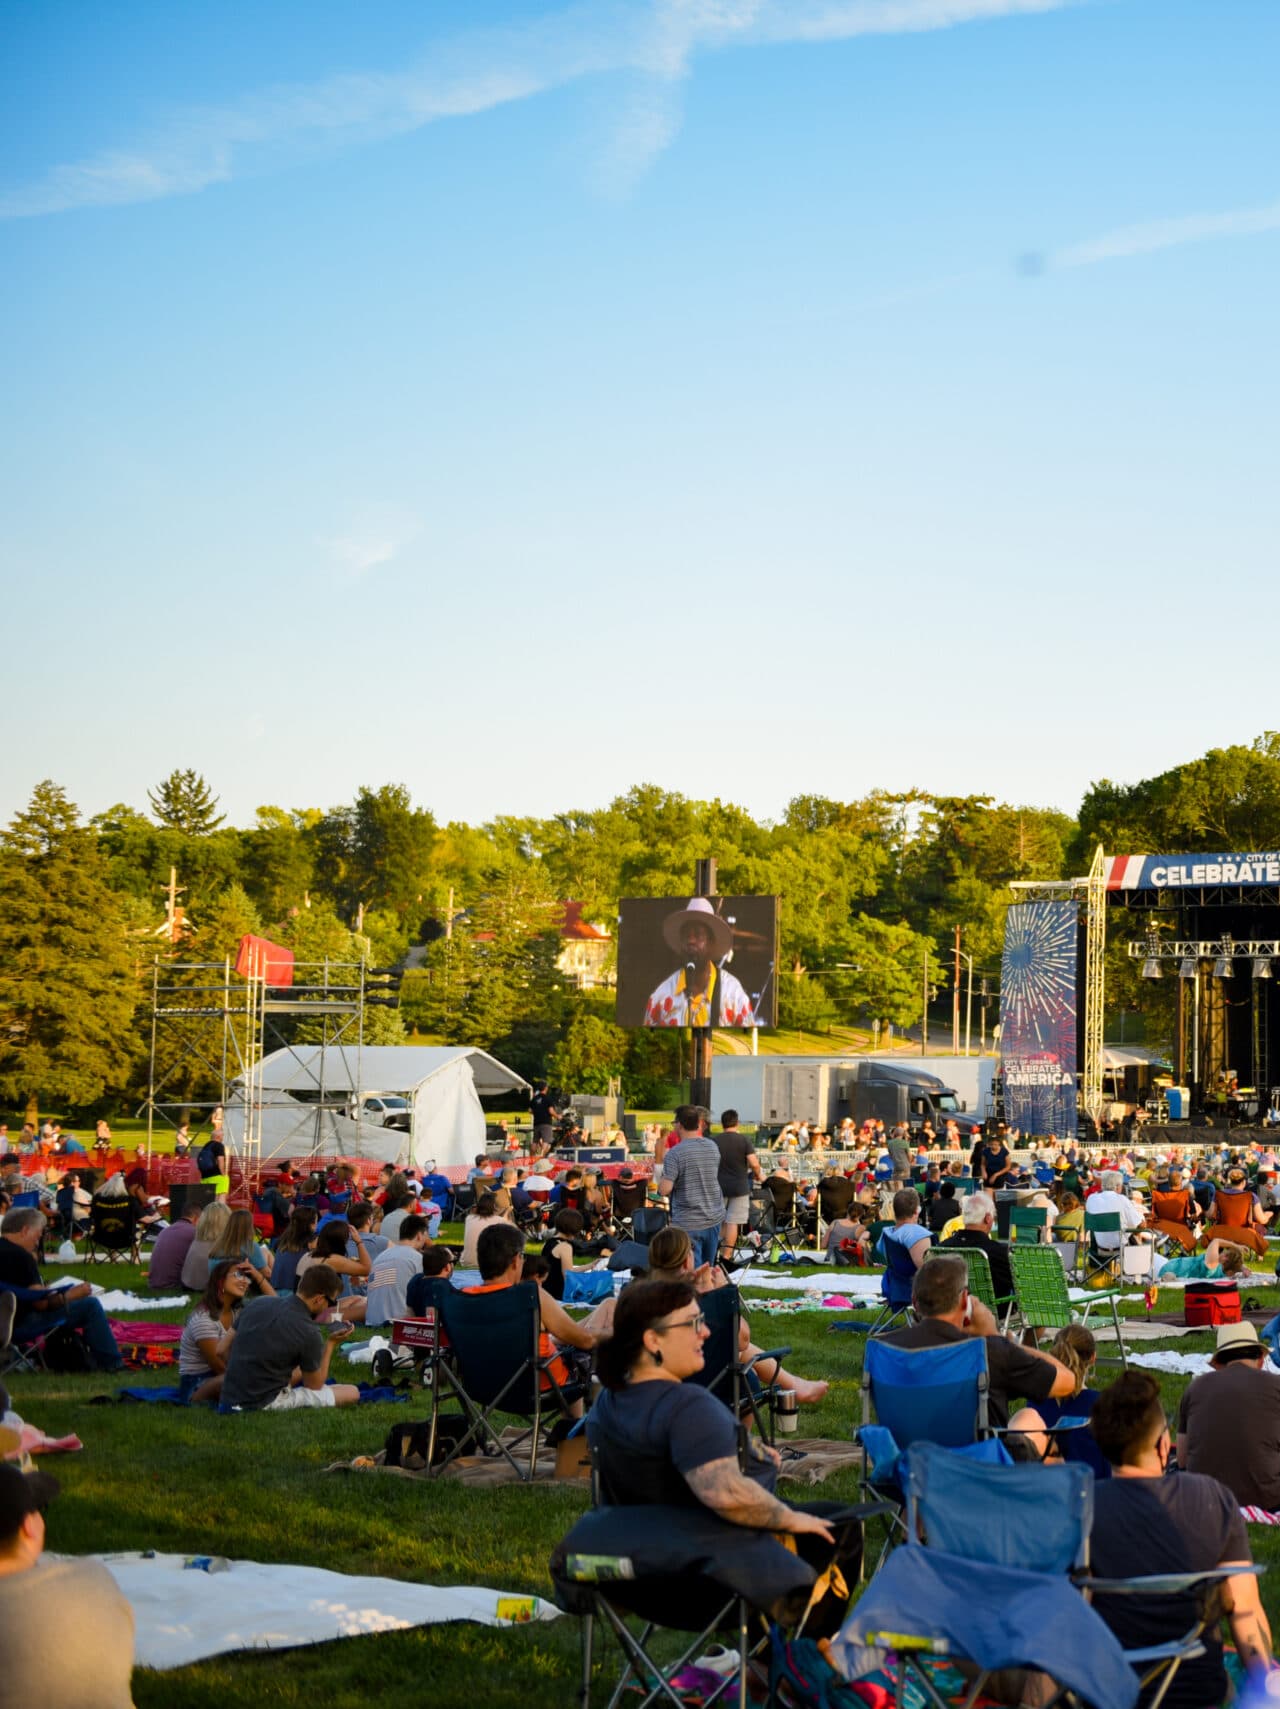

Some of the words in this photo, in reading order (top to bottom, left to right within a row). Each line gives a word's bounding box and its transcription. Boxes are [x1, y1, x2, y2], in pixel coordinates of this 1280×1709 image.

[1246, 854, 1264, 862] CITY
[1265, 853, 1277, 862] OF
[1004, 1064, 1062, 1074] CELEBRATES
[1006, 1072, 1073, 1086] AMERICA
